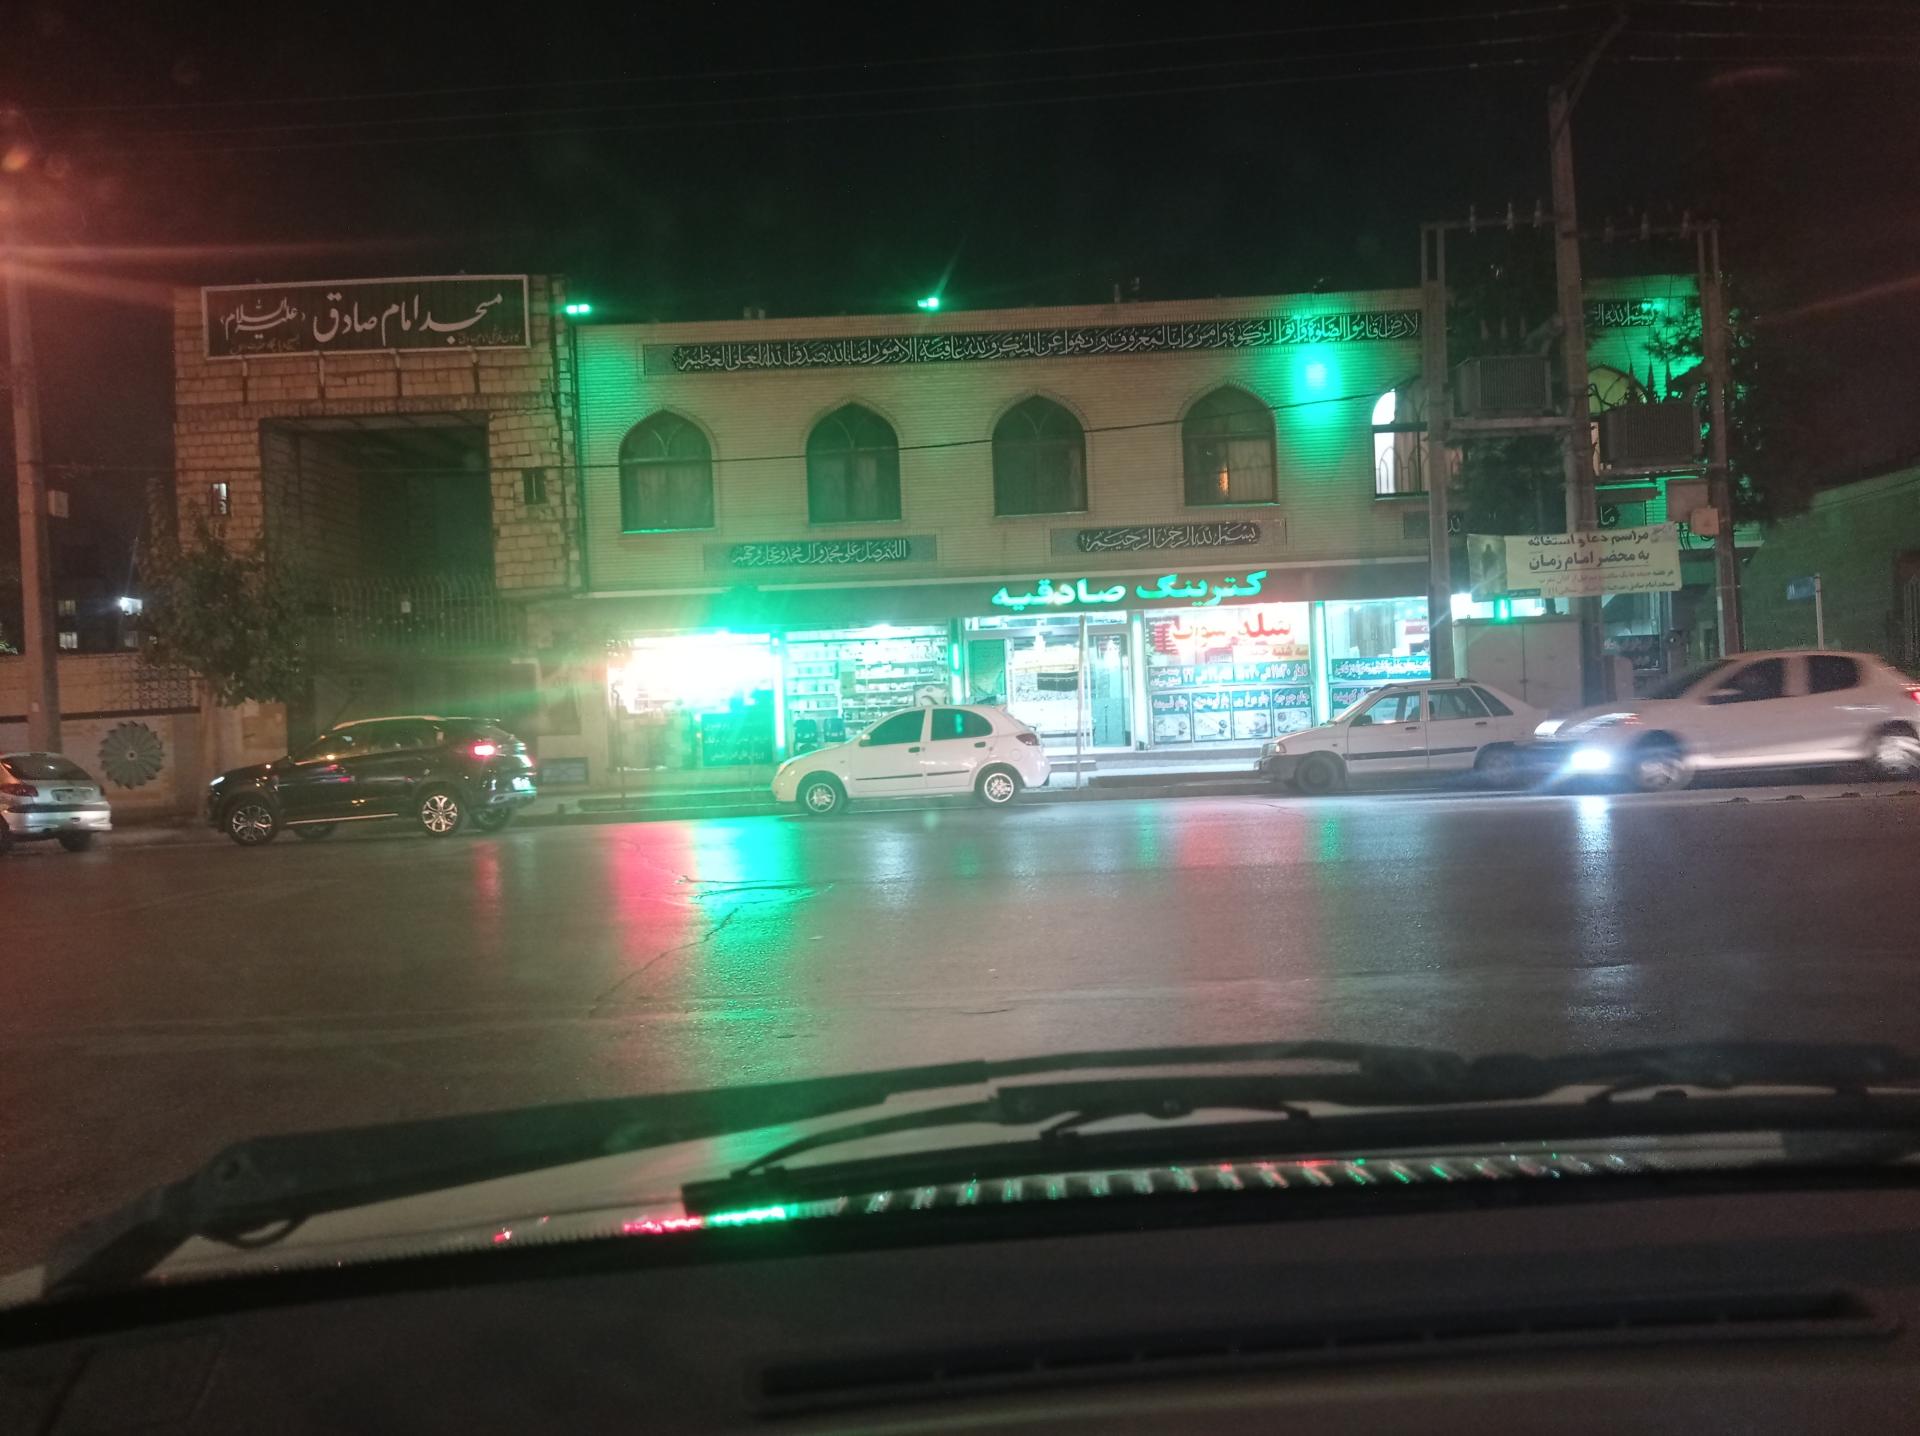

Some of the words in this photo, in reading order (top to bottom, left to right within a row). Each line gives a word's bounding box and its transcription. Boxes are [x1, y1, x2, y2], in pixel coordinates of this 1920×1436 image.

[313, 292, 379, 343] صادق
[381, 294, 420, 347] امام
[419, 292, 503, 345] مسجد
[1527, 533, 1576, 547] استغاثه
[1577, 537, 1587, 548] و
[1586, 533, 1609, 544] دعا
[1611, 530, 1649, 545] مراسم
[1528, 554, 1563, 571] زمان
[1564, 551, 1594, 571] امام
[1596, 551, 1636, 568] محضر
[1637, 548, 1650, 564] به
[990, 576, 1127, 612] صادقیه
